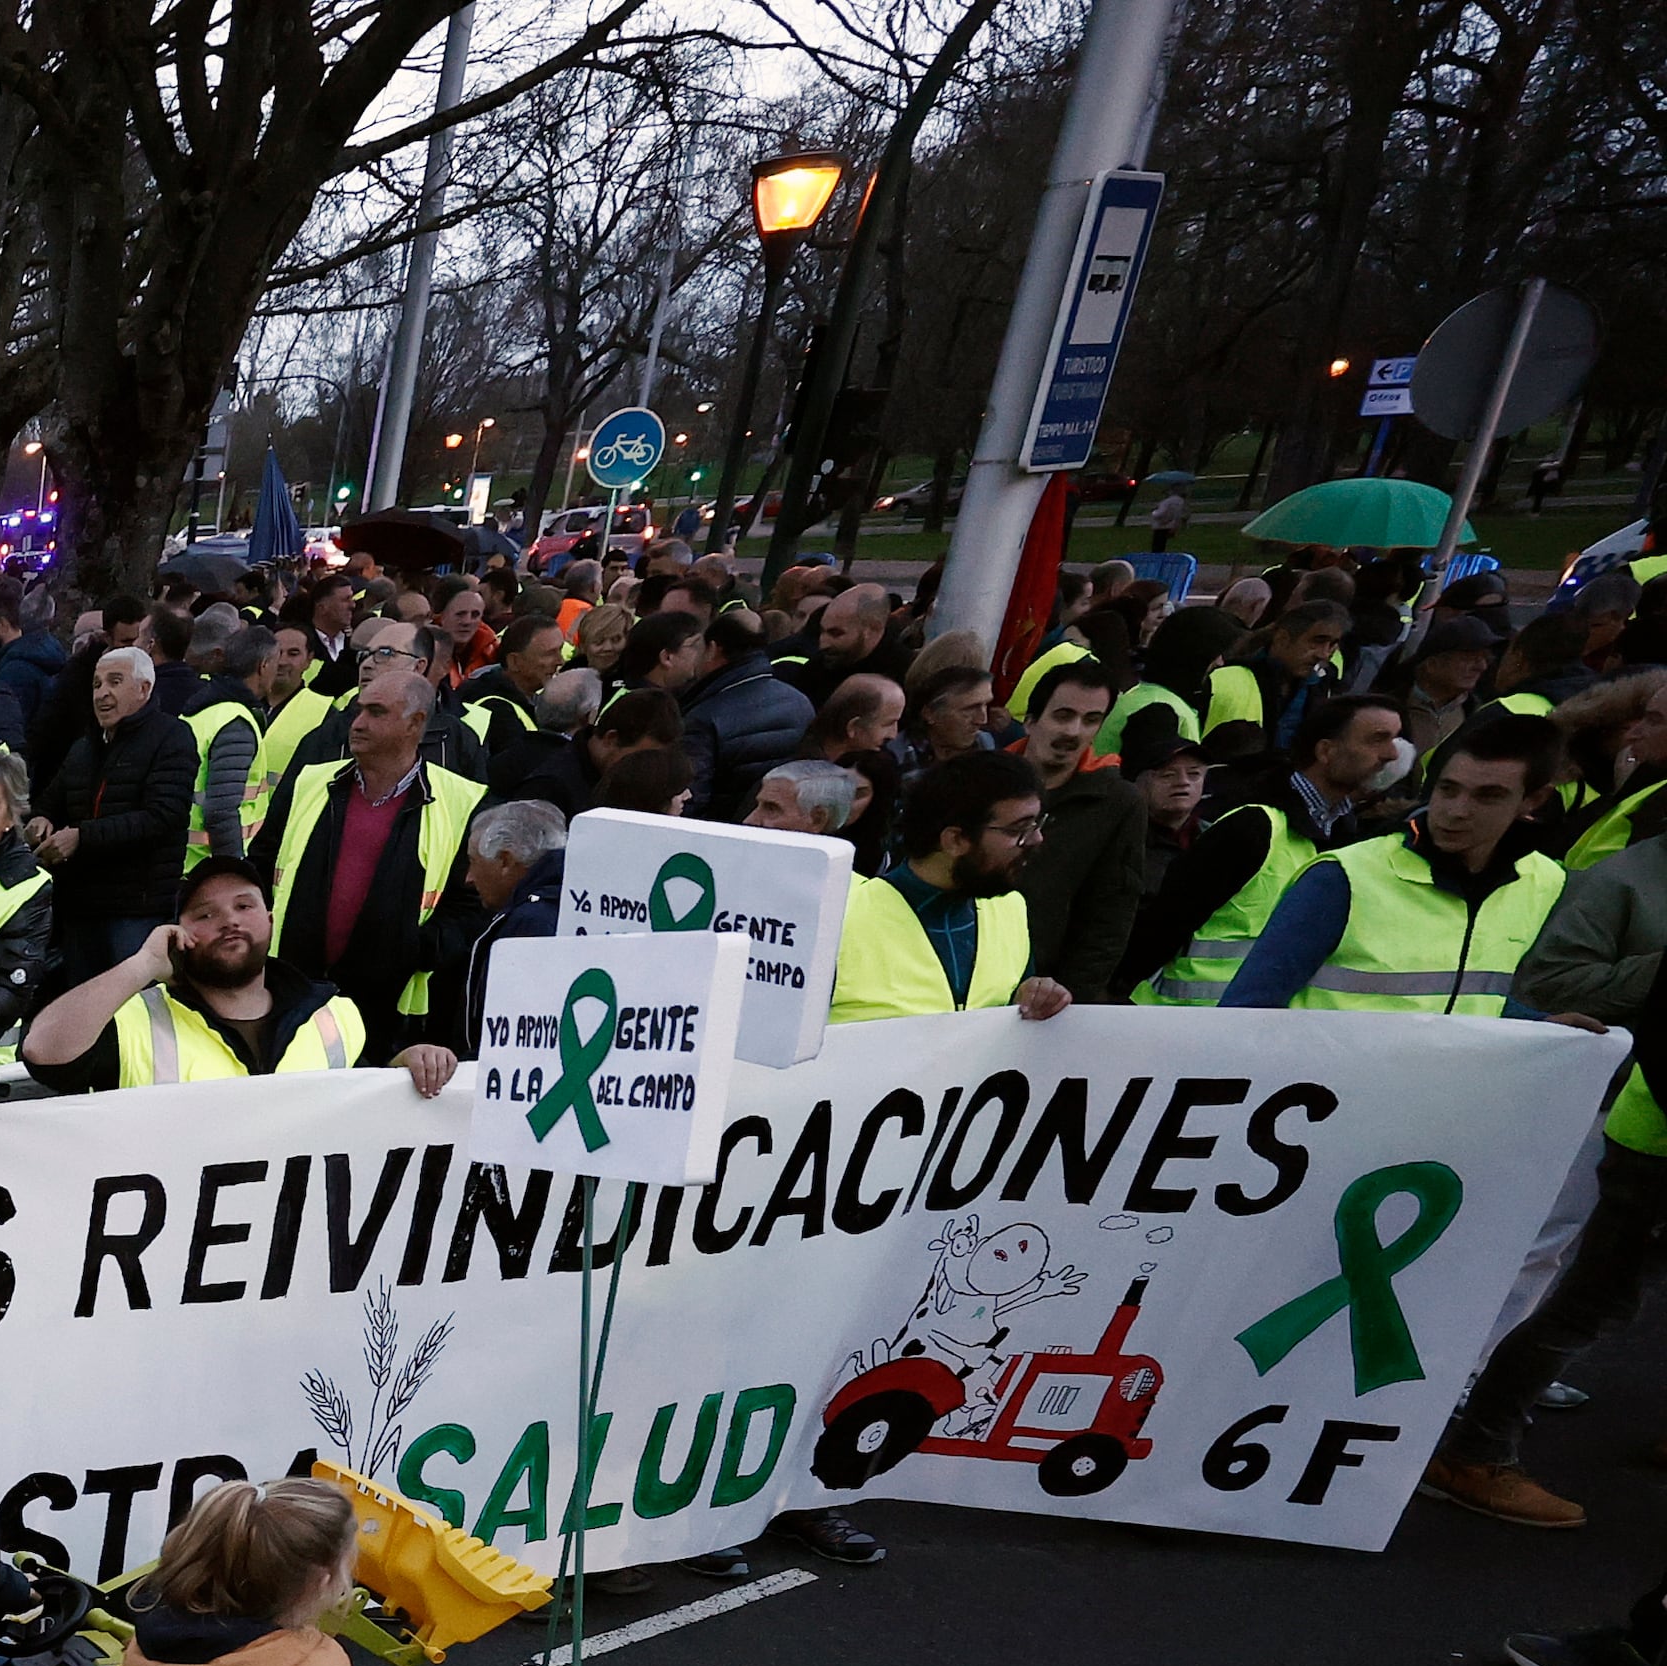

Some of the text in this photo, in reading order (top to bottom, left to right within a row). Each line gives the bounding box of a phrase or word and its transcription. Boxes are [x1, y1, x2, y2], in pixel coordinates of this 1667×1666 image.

[601, 894, 647, 923] APOYO
[713, 911, 798, 947] GENTE
[486, 1015, 558, 1049] YO APOYO
[615, 1005, 700, 1052] GENTE
[486, 1067, 543, 1102] A LA
[597, 1073, 696, 1111] DEL CAMPO
[74, 1069, 1339, 1318] REIVINDICACIONES
[396, 1382, 798, 1547] SALUD
